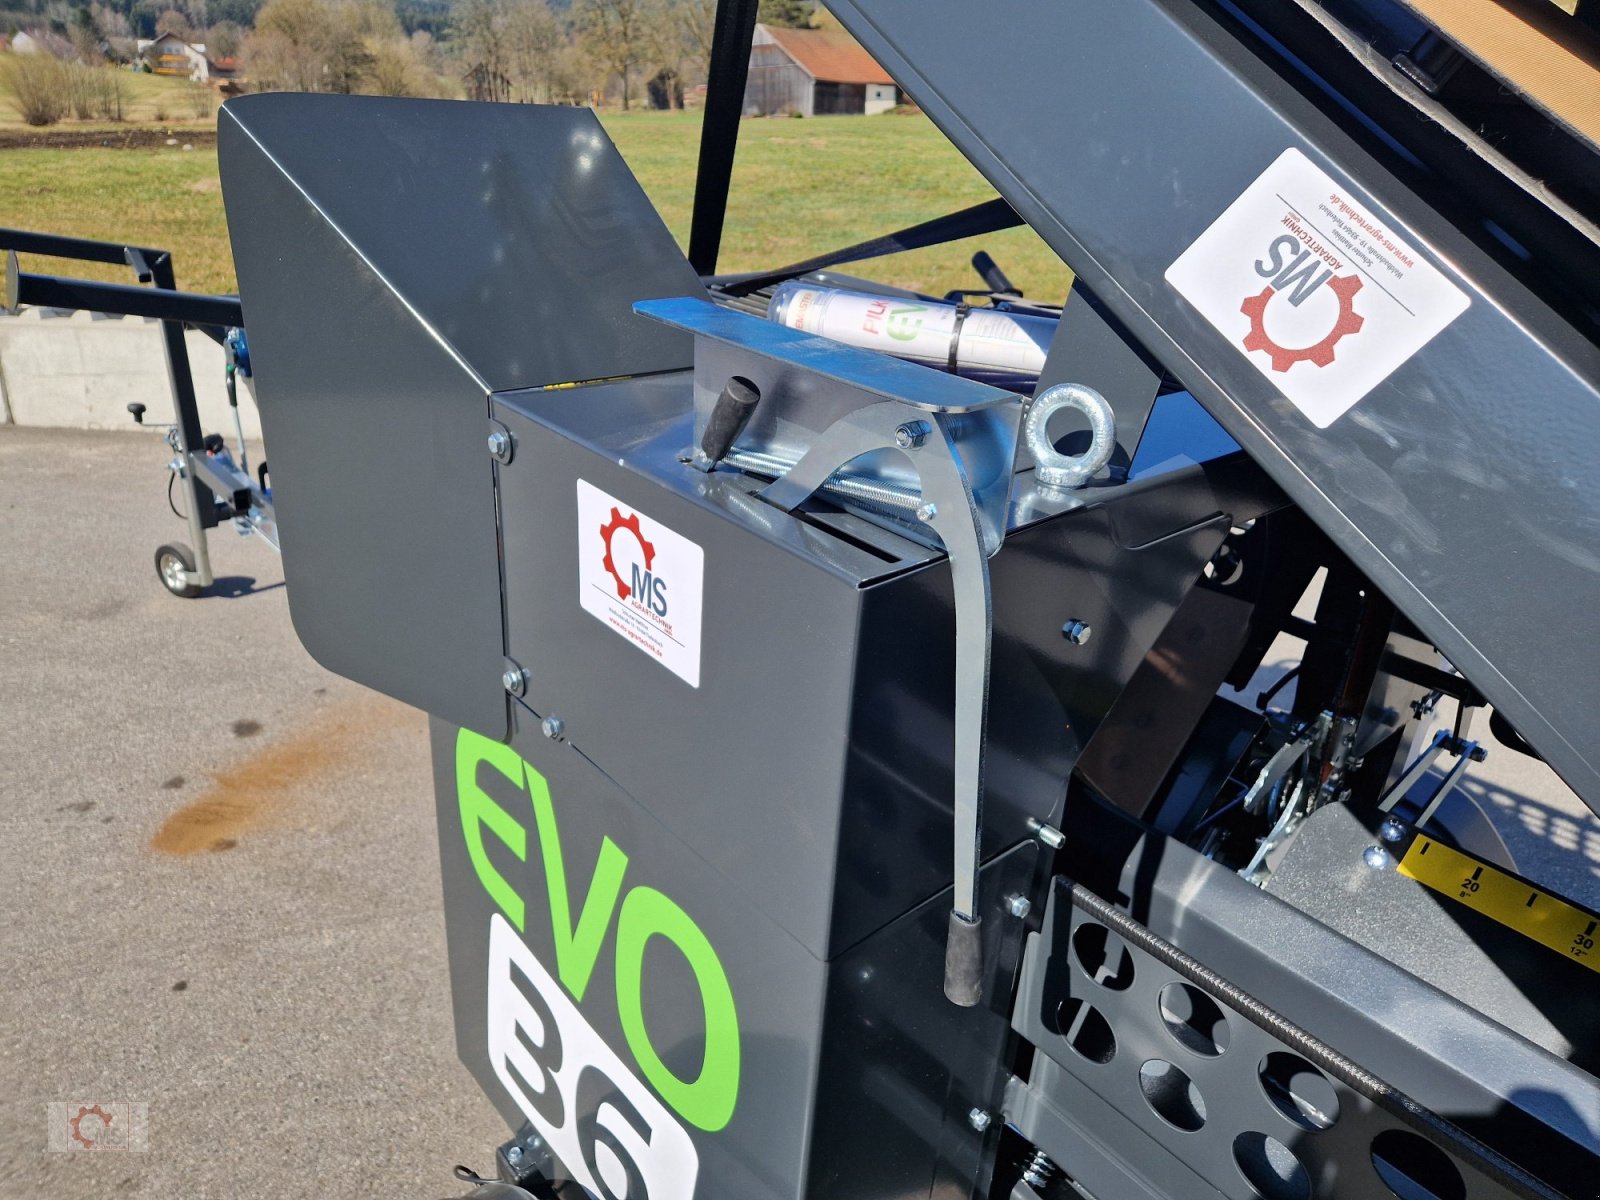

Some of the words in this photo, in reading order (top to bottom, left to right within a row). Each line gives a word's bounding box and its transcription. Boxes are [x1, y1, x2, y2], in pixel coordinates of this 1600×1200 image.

[1318, 203, 1344, 228] Tiefenbach
[1330, 194, 1414, 268] www.ms-agrartechnik.de
[1281, 216, 1343, 270] AGRARTECHNIK
[1351, 247, 1373, 267] Schuster
[1255, 233, 1334, 307] MS
[632, 561, 667, 617] MS
[631, 600, 673, 631] AGRARTECHNIK
[1461, 878, 1480, 893] 20
[456, 727, 740, 1132] EVO
[1573, 934, 1594, 950] 30
